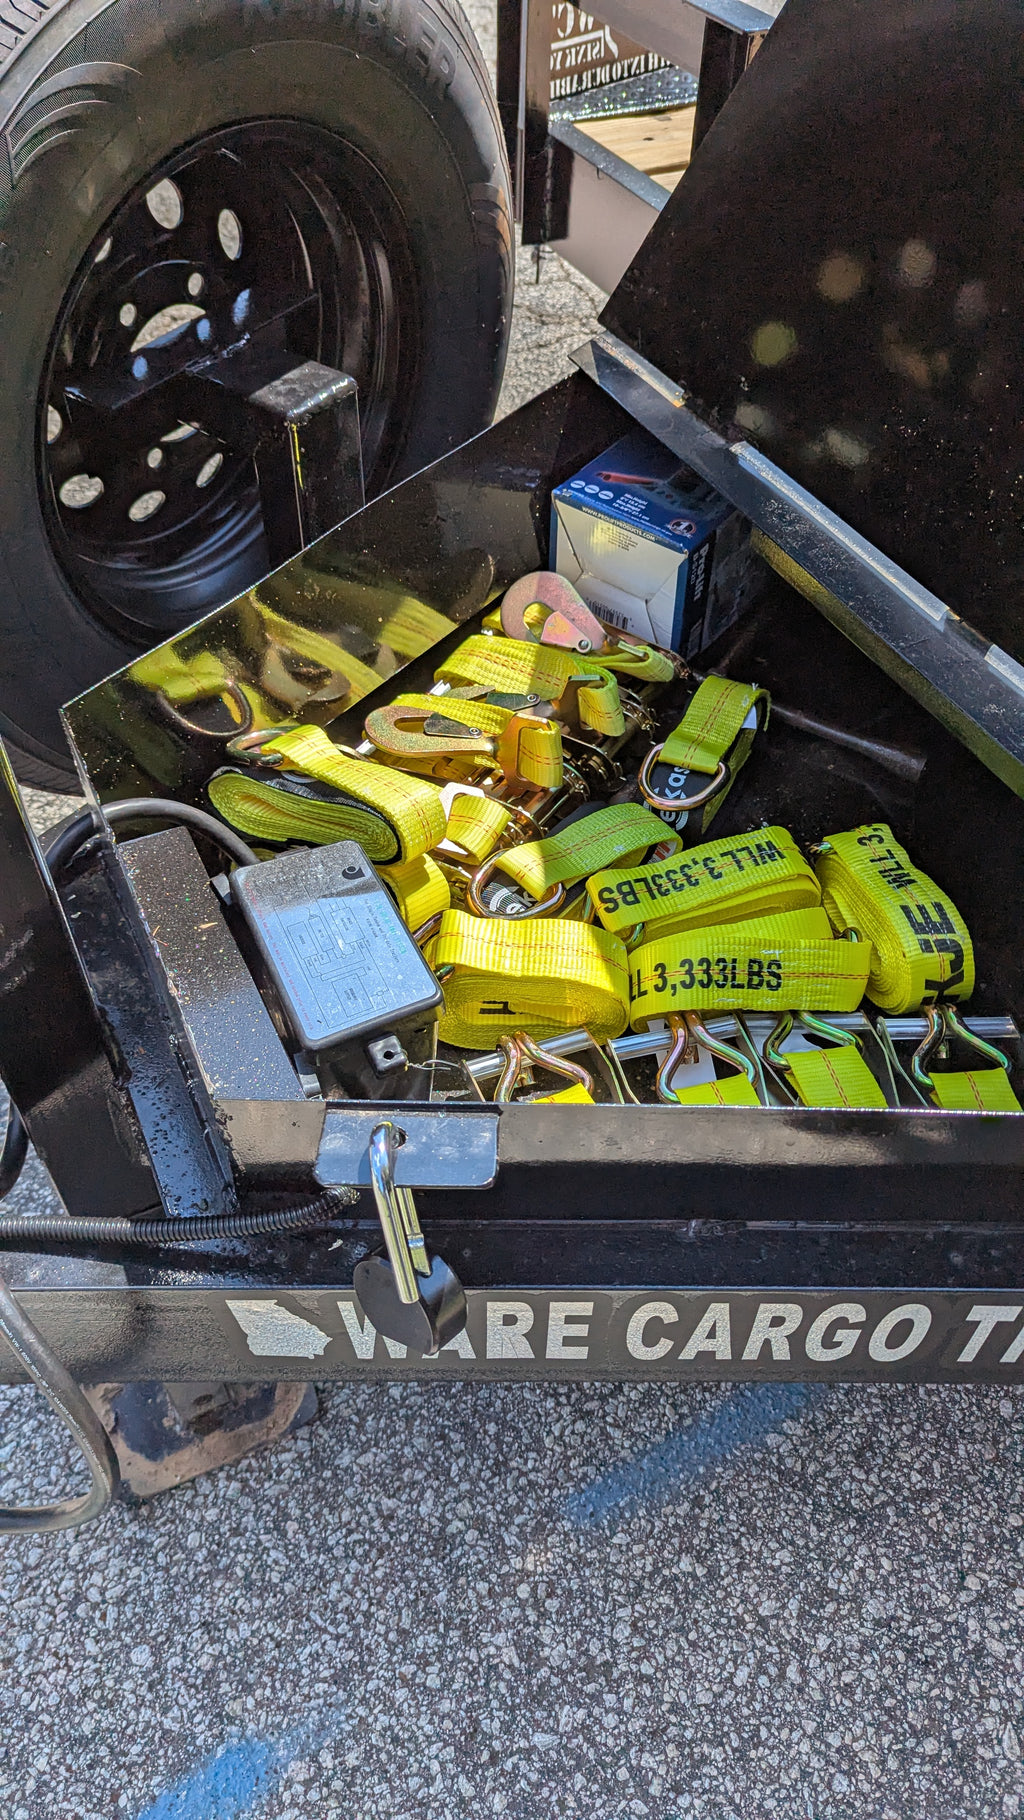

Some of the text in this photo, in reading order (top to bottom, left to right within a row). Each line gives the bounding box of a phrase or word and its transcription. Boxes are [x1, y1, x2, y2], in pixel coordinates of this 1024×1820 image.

[720, 840, 786, 872] WLL
[598, 857, 723, 914] 3,333LBS
[629, 957, 782, 1002] LL 3,333LBS
[626, 1302, 932, 1362] CARGO
